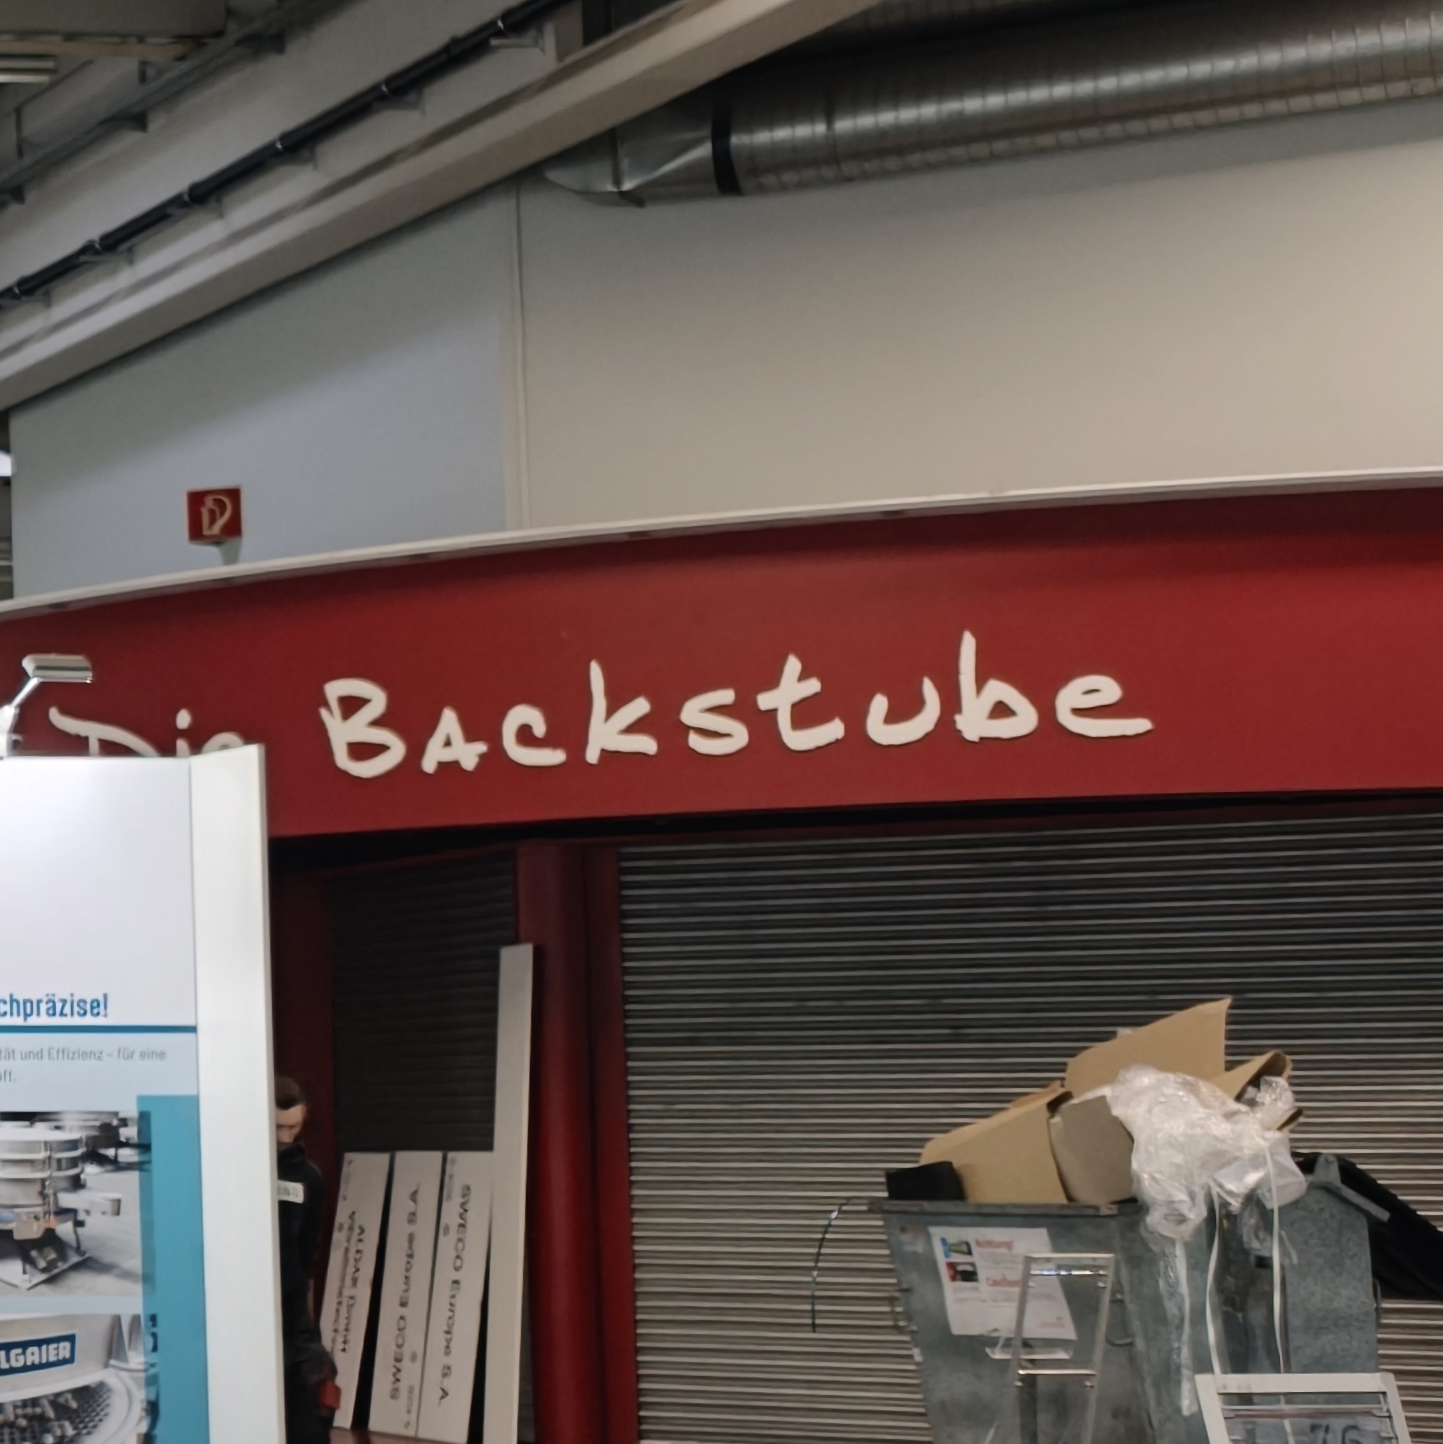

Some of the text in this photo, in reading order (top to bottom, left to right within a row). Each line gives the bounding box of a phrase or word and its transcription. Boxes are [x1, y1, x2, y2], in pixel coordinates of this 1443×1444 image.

[20, 1048, 43, 1061] und
[47, 1047, 103, 1062] Effizienz
[117, 1047, 135, 1062] für
[139, 1048, 166, 1062] eine
